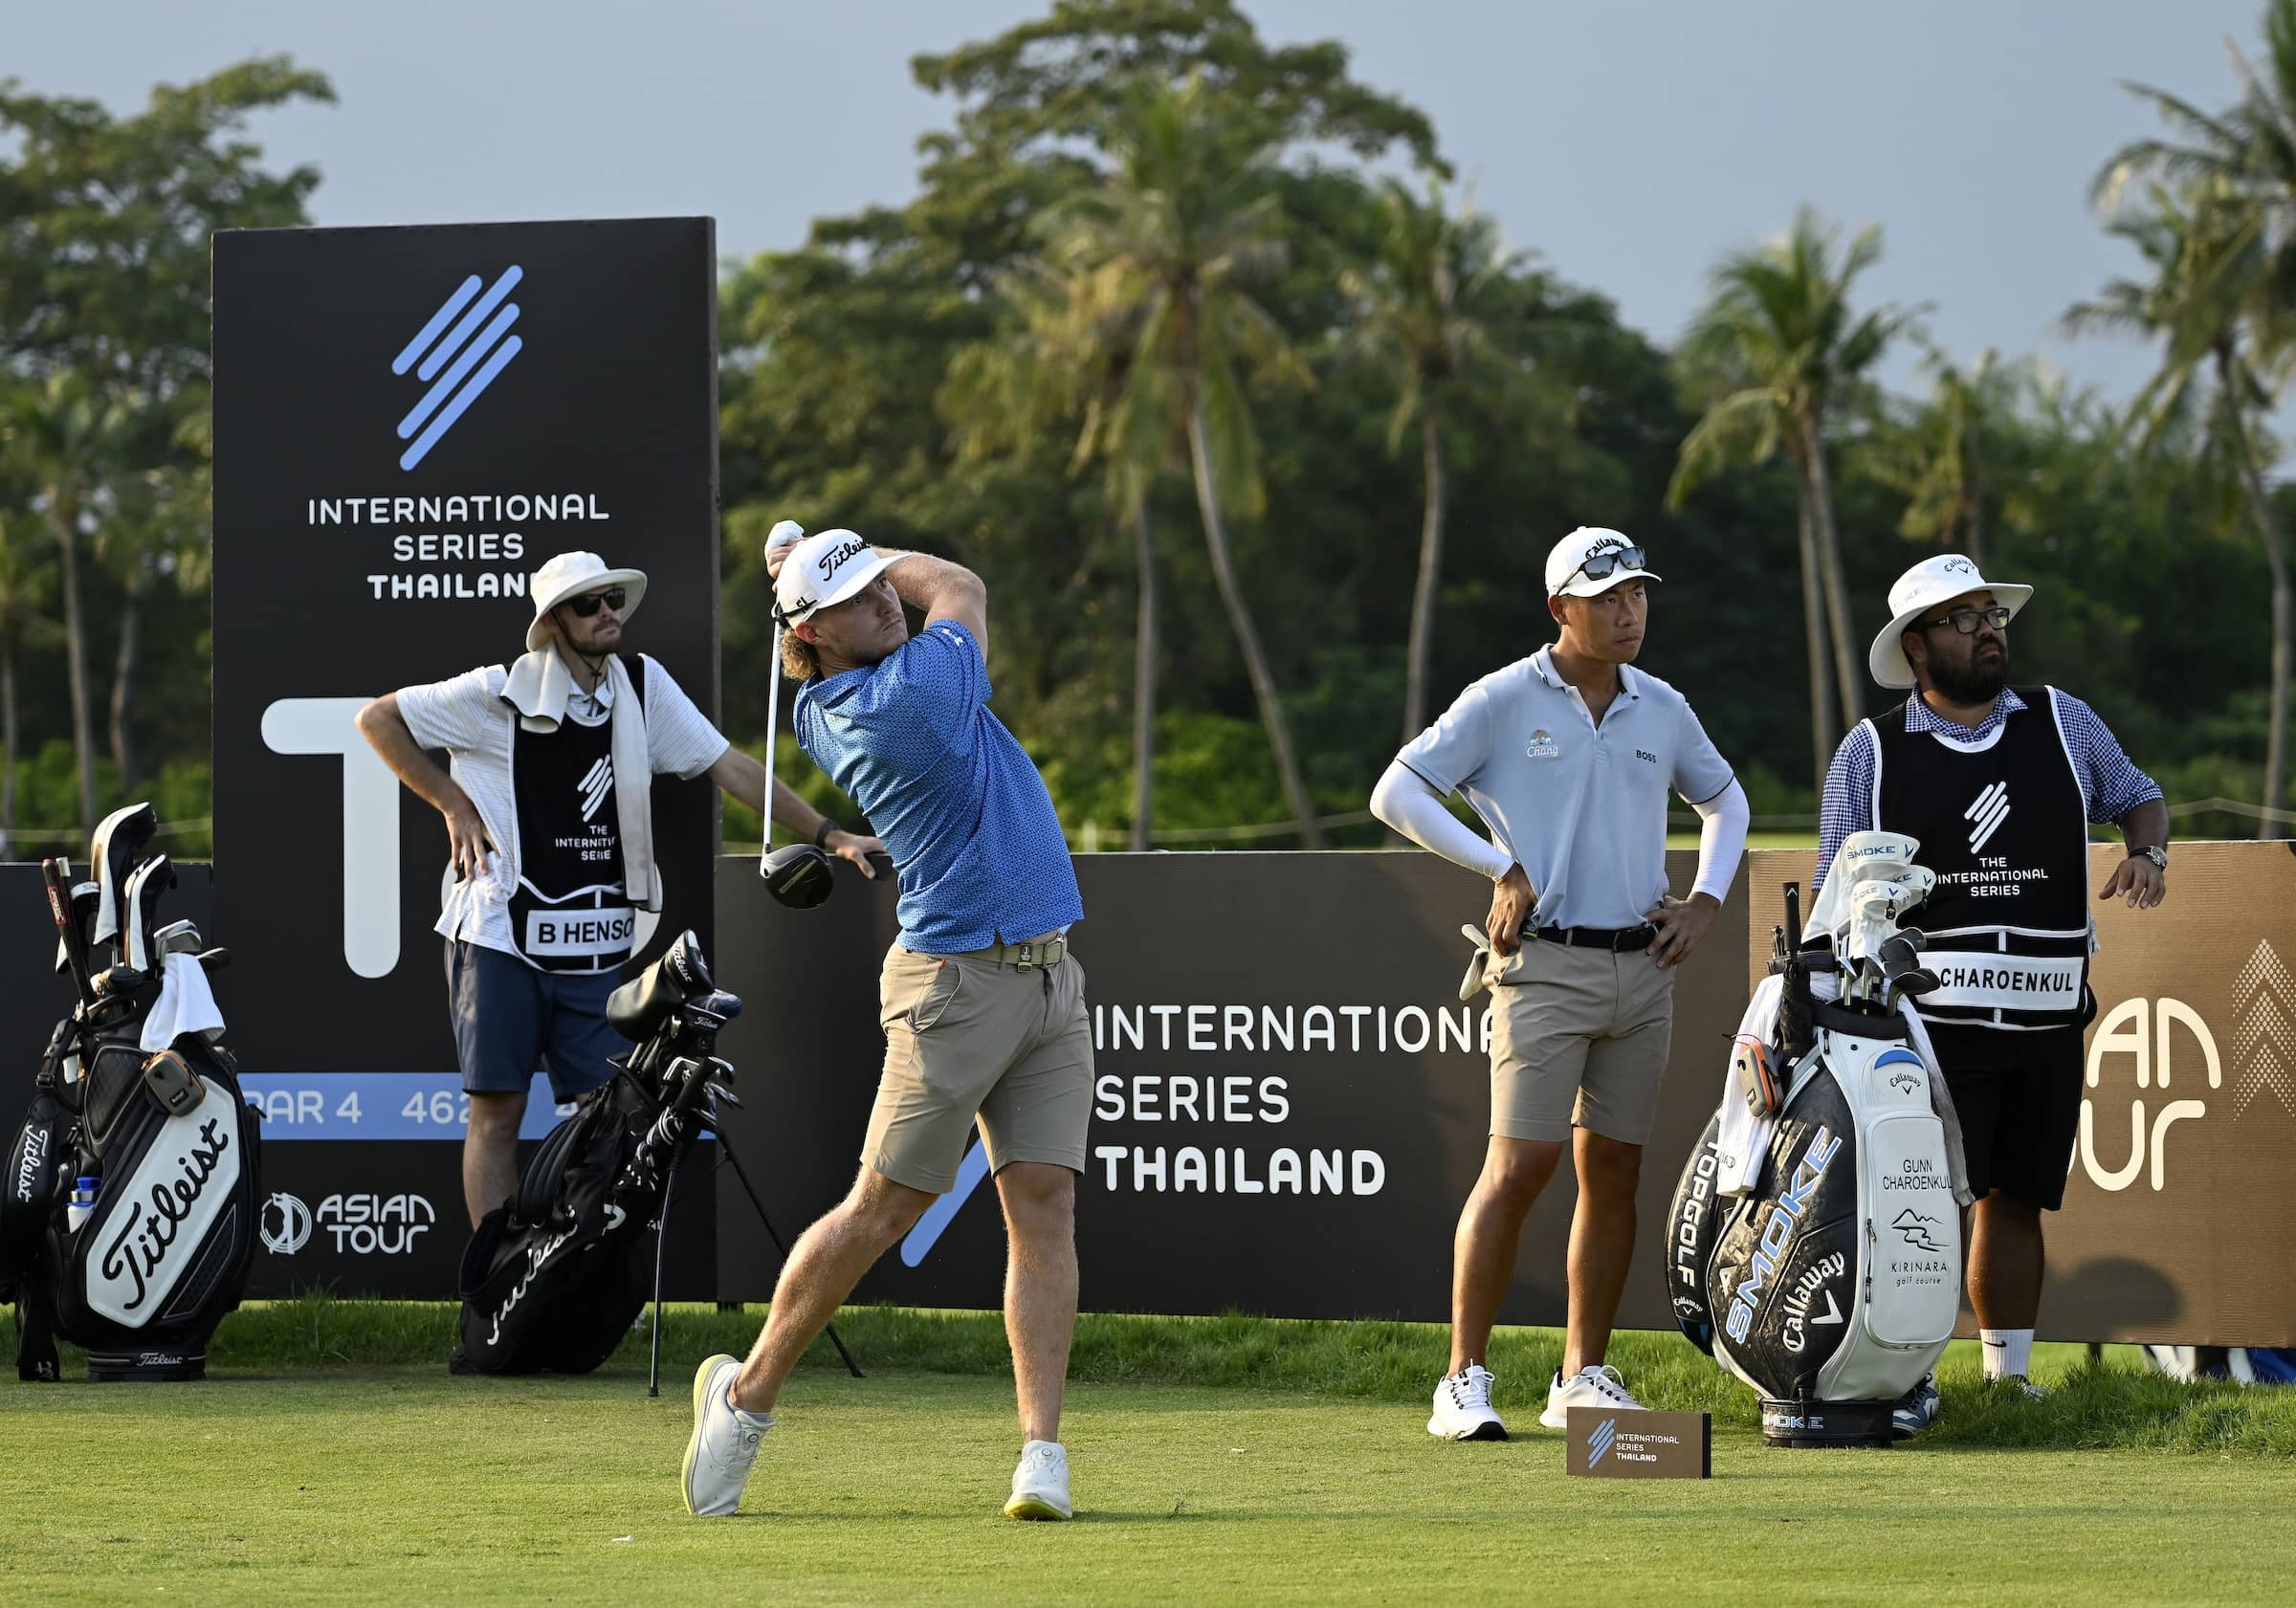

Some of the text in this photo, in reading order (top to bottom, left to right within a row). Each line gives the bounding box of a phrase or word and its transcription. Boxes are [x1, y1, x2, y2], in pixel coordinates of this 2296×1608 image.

[308, 494, 609, 525] INTERNATIONAL
[393, 533, 524, 562] SERIES
[366, 572, 536, 600] THAILAN
[1527, 745, 1558, 758] Chang
[1636, 750, 1657, 763] BOSS
[588, 825, 607, 835] THE
[1846, 846, 1896, 860] SMOKE
[1979, 857, 2007, 868] THE
[1937, 869, 2049, 885] INTERNATIONAL
[1971, 885, 2020, 896] SERIES
[539, 923, 556, 943] B
[1940, 968, 2074, 992] CHAROENKUL
[1889, 1072, 1921, 1088] Callaway
[336, 1090, 362, 1124] 4
[1095, 1075, 1290, 1123] SERIES
[17, 1124, 48, 1201] Titleist
[1903, 1158, 1932, 1174] GUNN
[1094, 1146, 1386, 1197] THAILAND
[1883, 1176, 1953, 1190] CHAROENKUL
[101, 1118, 229, 1311] Titleist
[316, 1193, 436, 1223] ASIAN
[1725, 1125, 1843, 1345] SMOKE
[1891, 1262, 1948, 1273] KIRINARA
[1897, 1276, 1912, 1288] golf
[1673, 1295, 1704, 1313] Callaway
[1783, 1251, 1846, 1354] Callaway
[136, 1352, 183, 1367] Titleist
[1616, 1434, 1680, 1444] INTERNATIONAL
[1616, 1443, 1645, 1452] SERIES
[1616, 1452, 1657, 1463] THAILAND
